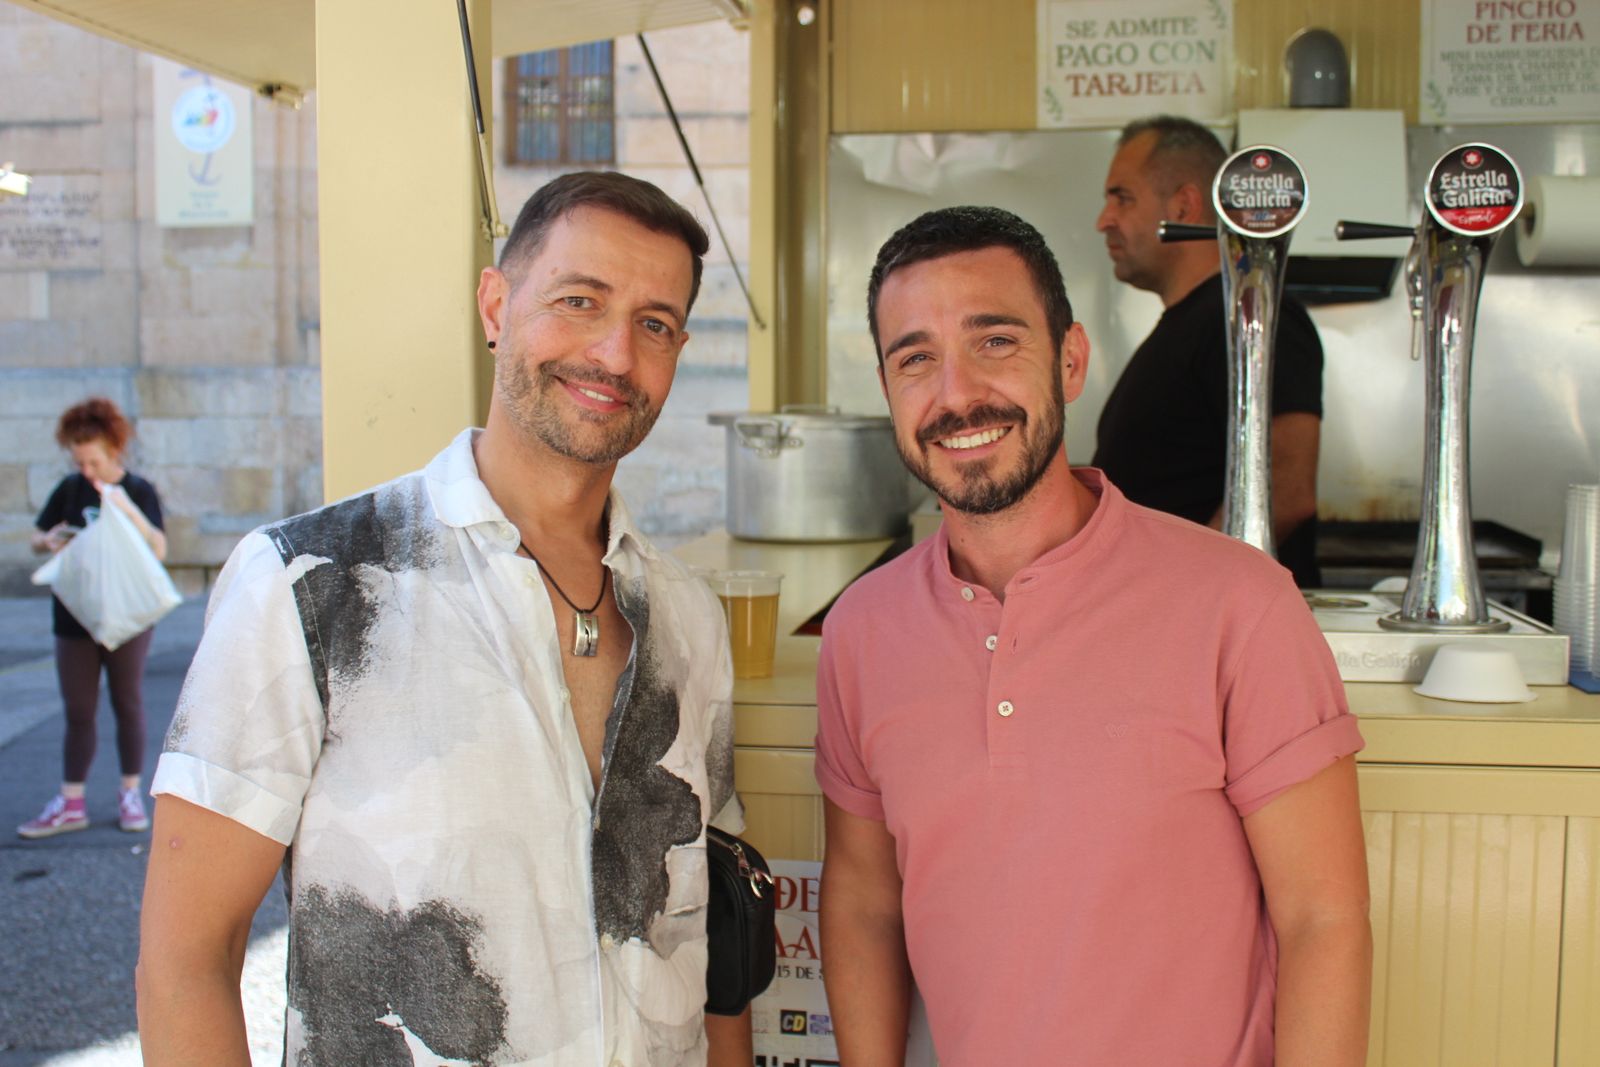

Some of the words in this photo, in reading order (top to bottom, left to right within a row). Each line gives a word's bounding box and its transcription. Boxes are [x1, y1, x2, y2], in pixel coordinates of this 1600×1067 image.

[1475, 0, 1577, 20] PINCHO
[1065, 19, 1097, 39] SE
[1103, 16, 1198, 38] ADMITE
[1466, 24, 1500, 44] DE
[1510, 21, 1586, 43] FERIA
[1056, 42, 1139, 67] PAGO
[1149, 39, 1217, 65] CON
[1065, 70, 1206, 97] TARJETA
[1229, 173, 1294, 191] Estrella
[1440, 170, 1508, 190] Estrella
[1232, 190, 1292, 208] Galicia
[1443, 188, 1506, 208] Galicia
[773, 876, 820, 912] DE
[777, 965, 791, 979] 15
[796, 966, 815, 980] DE
[782, 1014, 806, 1032] CD
